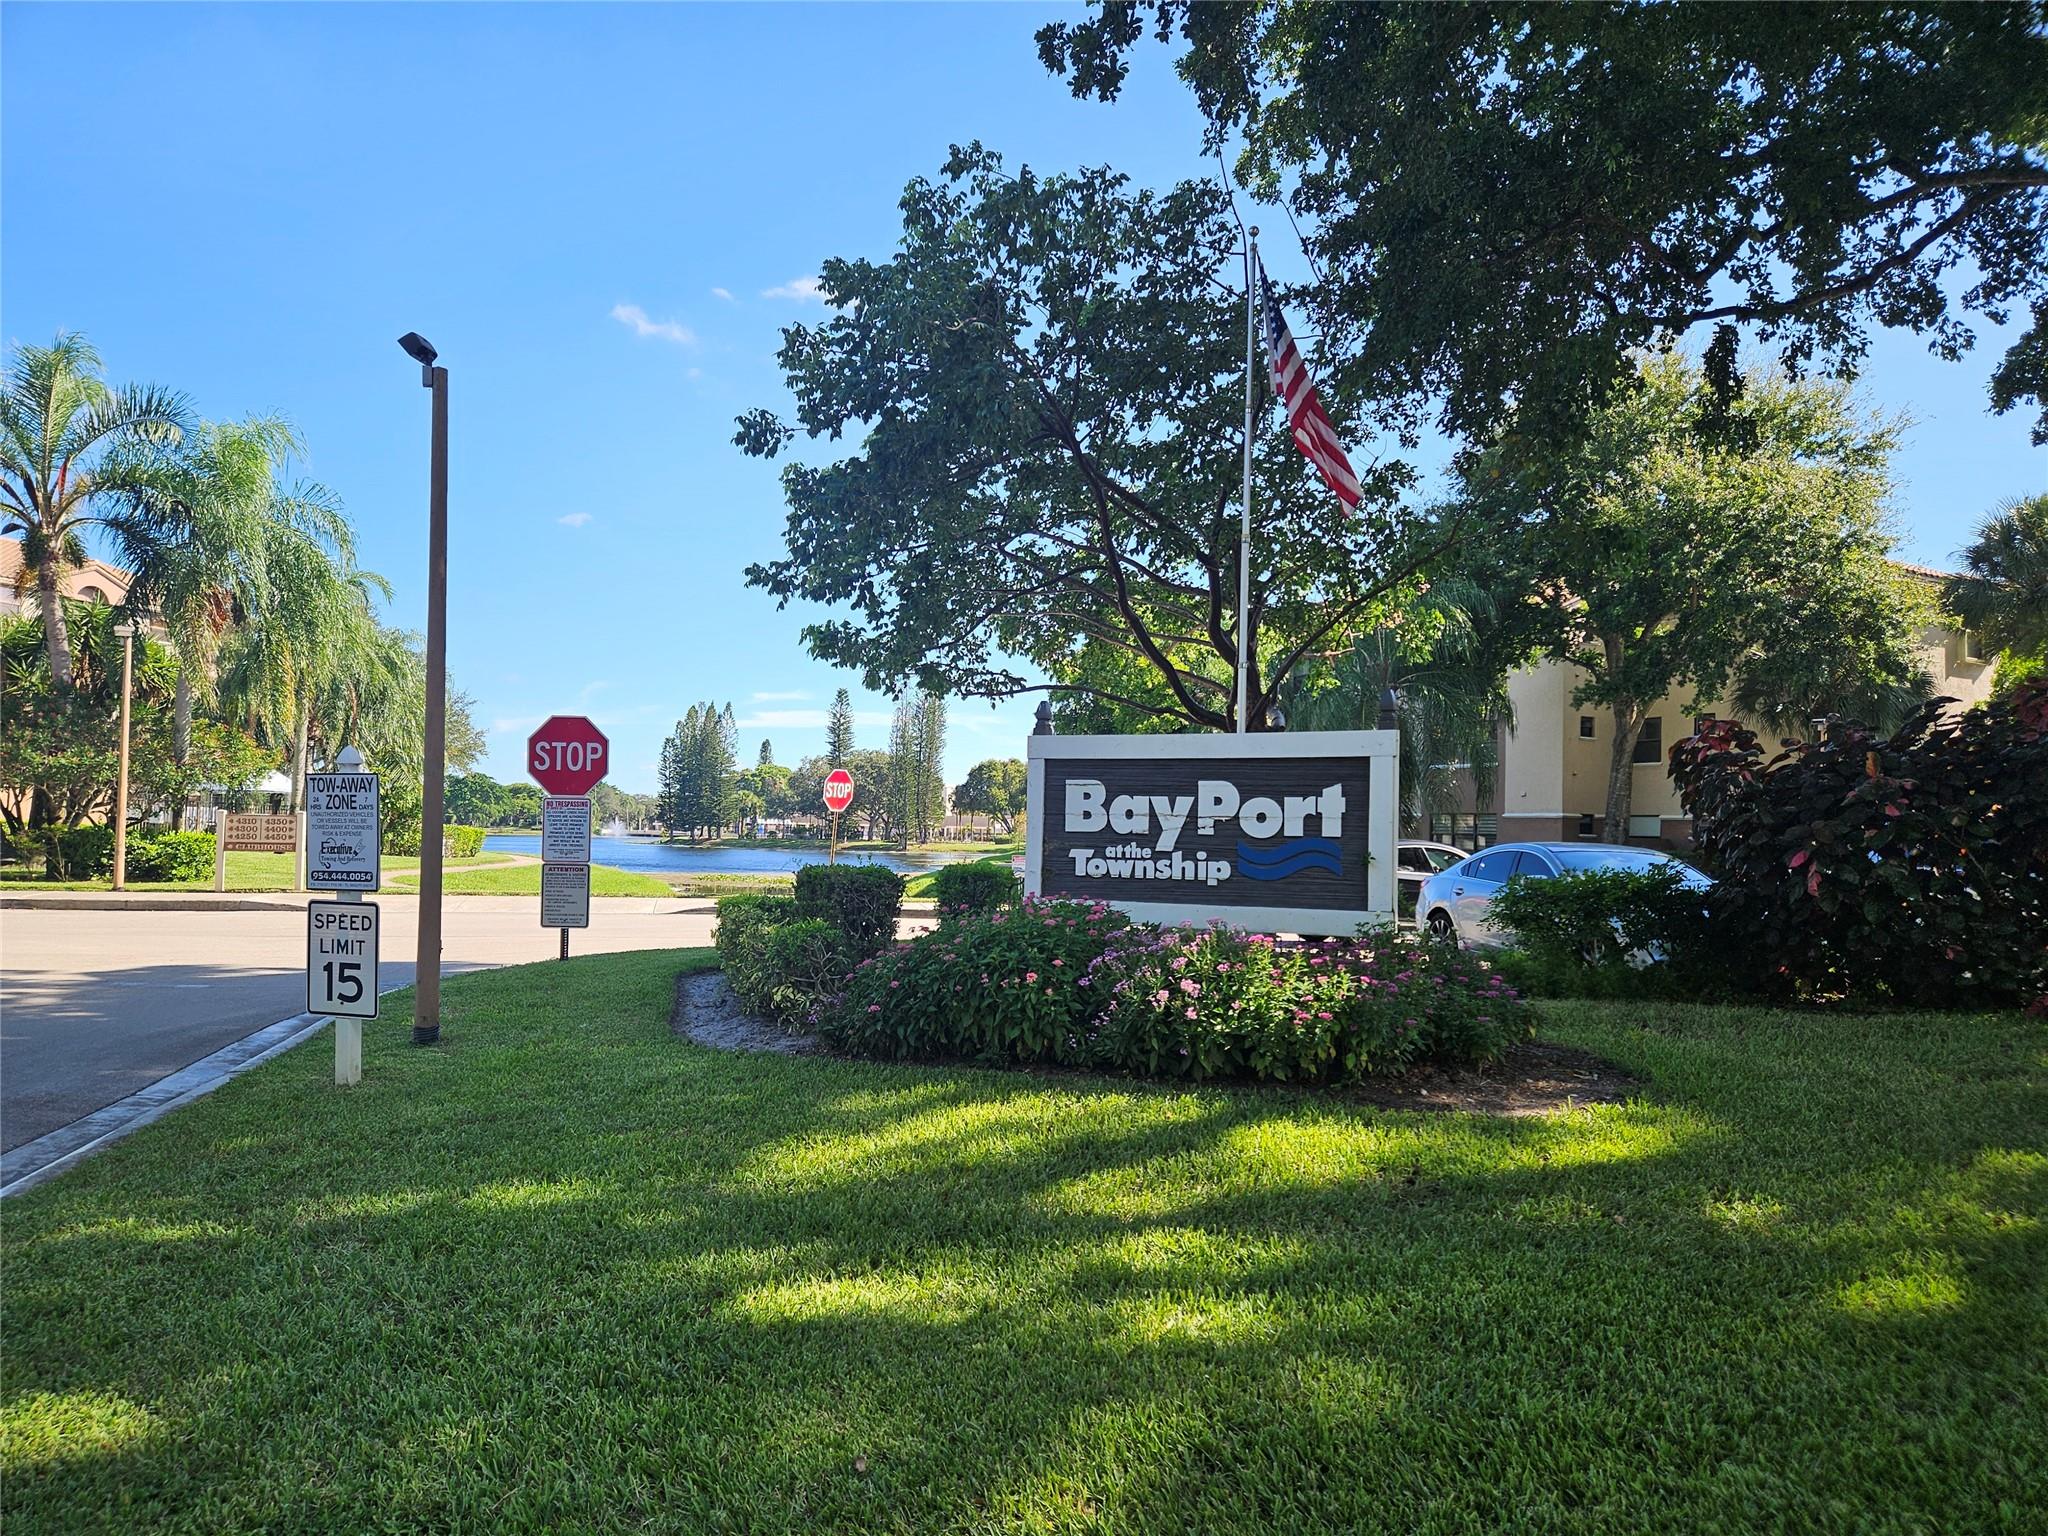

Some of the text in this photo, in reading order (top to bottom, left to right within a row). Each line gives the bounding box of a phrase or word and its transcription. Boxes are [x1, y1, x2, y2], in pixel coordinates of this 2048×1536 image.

[534, 741, 603, 771] STOP
[309, 777, 374, 793] TOW-AWAY
[826, 782, 851, 798] STOP
[325, 794, 357, 810] ZONE
[234, 825, 258, 833] 4300
[235, 843, 293, 851] CLUBHOUSE
[321, 841, 353, 855] Executive
[1068, 849, 1231, 886] Township
[312, 872, 372, 881] 954.444.0054
[314, 913, 372, 931] SPEED
[320, 938, 365, 955] LIMIT
[323, 961, 363, 1003] 15
